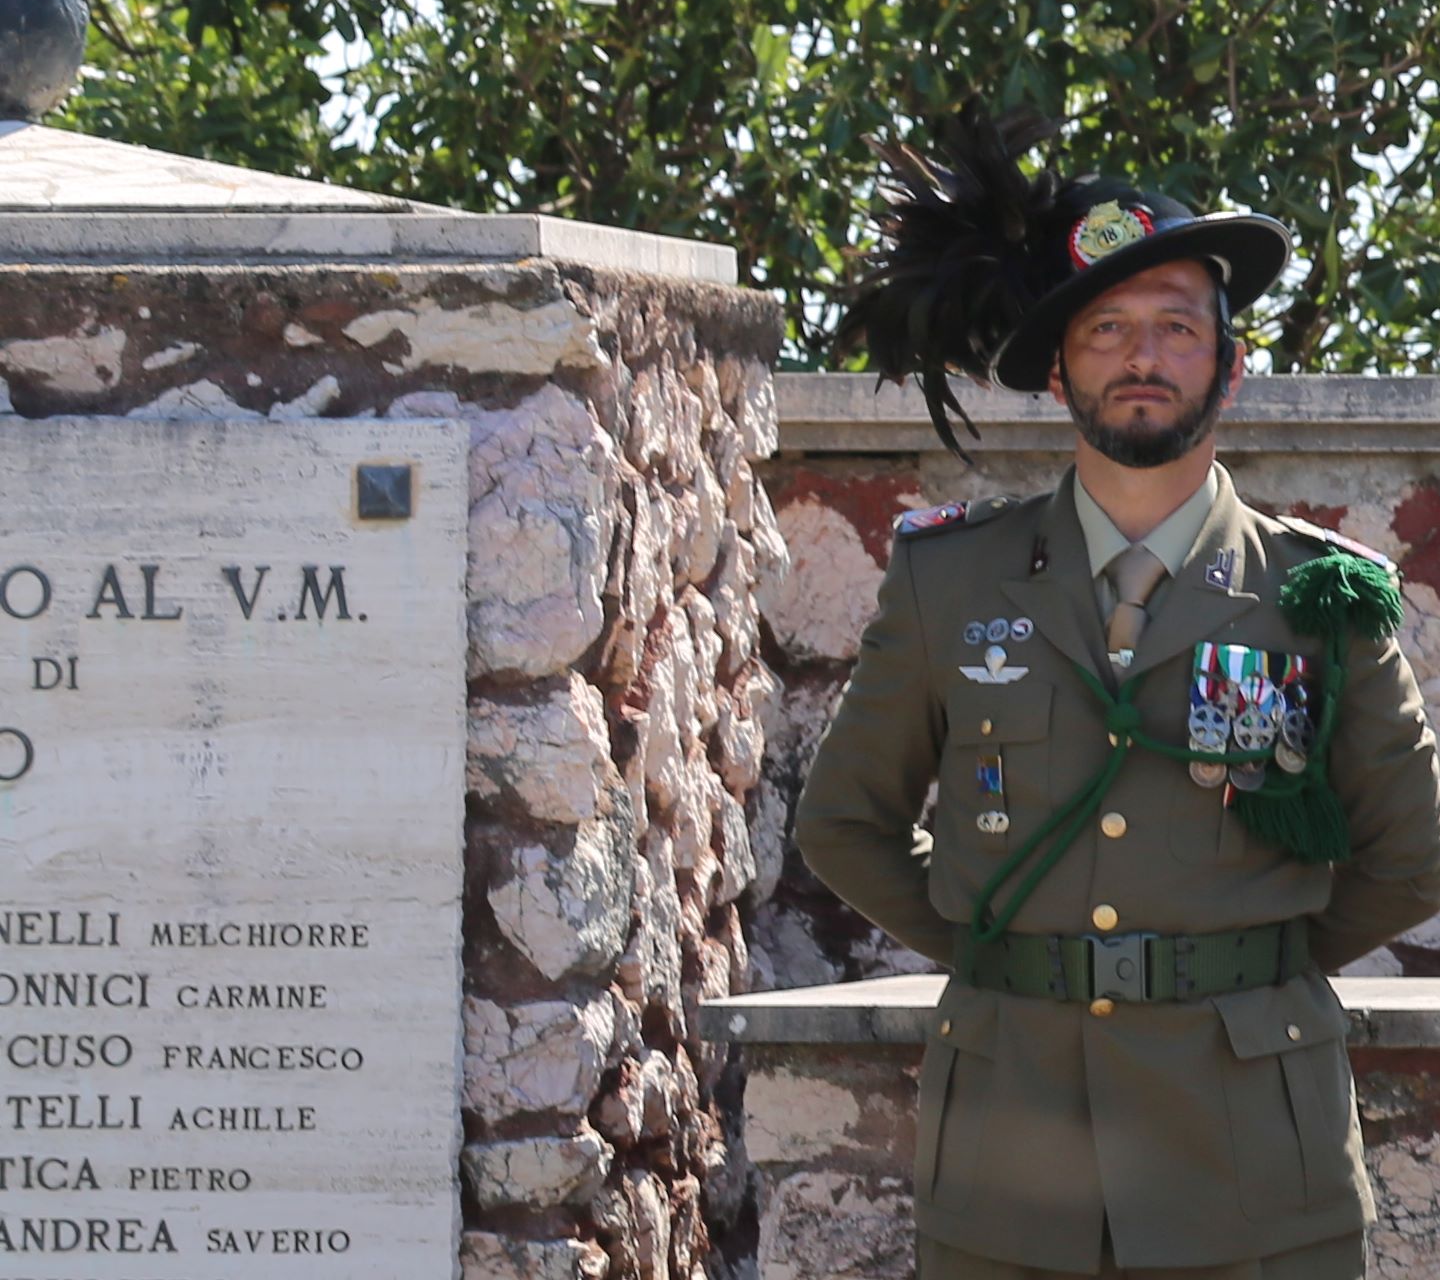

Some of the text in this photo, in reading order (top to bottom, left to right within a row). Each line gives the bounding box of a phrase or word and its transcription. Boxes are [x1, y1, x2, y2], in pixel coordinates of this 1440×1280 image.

[1102, 226, 1119, 245] 18
[85, 563, 183, 621] AL
[220, 565, 368, 622] V.M.
[32, 655, 79, 691] DI
[151, 922, 369, 948] MELCHIORRE
[176, 984, 327, 1009] CARMINE
[0, 1034, 364, 1071] CUSO FRANCESCO
[6, 1095, 316, 1131] TELLI ACHILLE
[129, 1167, 252, 1192] PIETRO
[207, 1228, 351, 1254] SAVERIO
